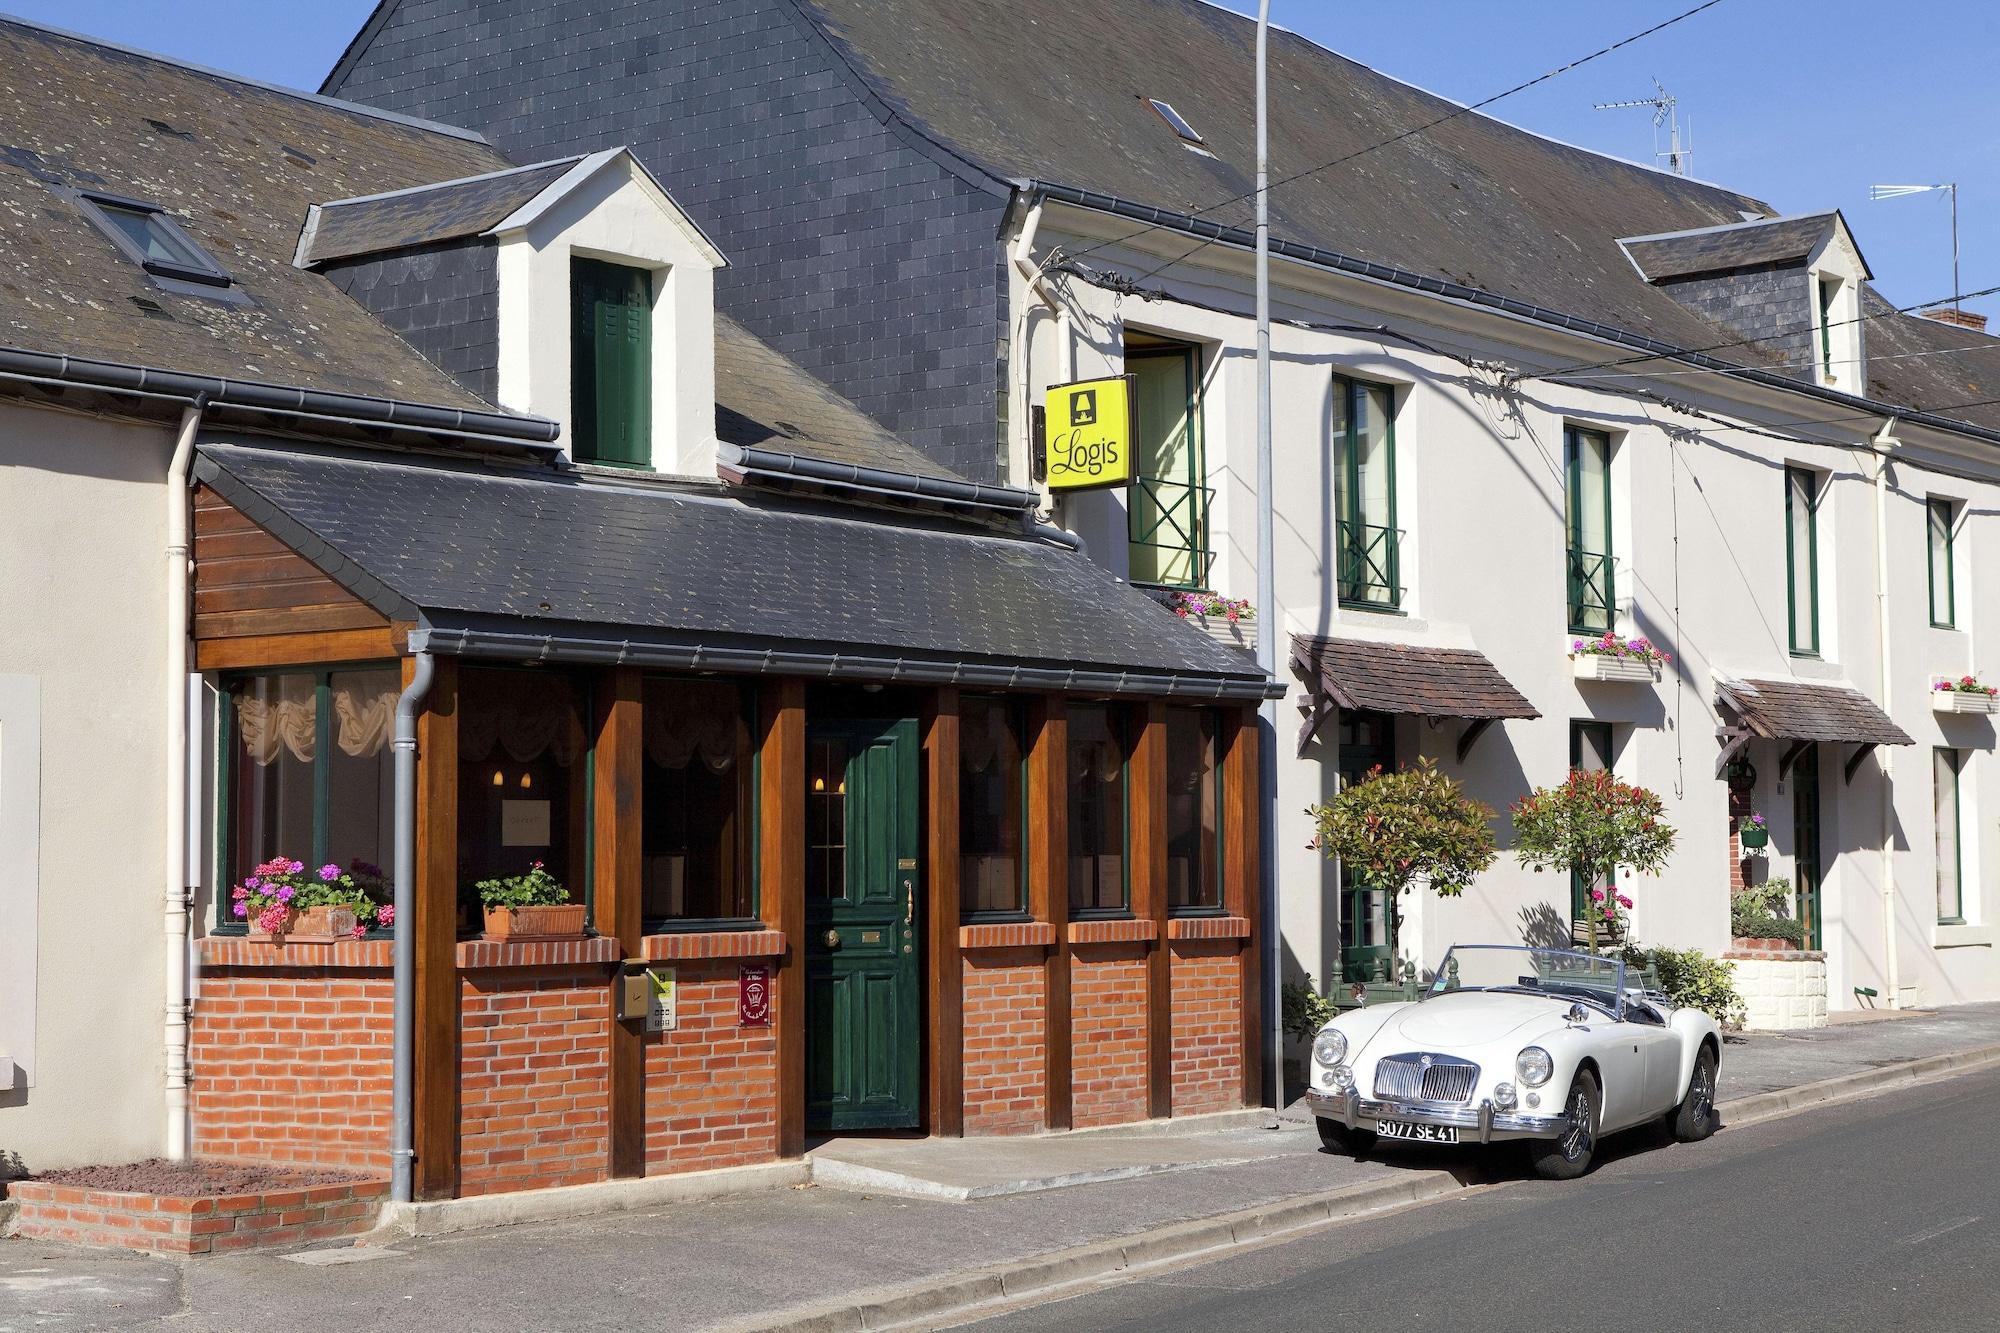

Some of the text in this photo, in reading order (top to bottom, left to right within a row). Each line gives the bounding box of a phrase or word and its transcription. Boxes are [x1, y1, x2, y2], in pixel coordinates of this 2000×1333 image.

[1051, 429, 1118, 475] Logis
[1379, 1120, 1455, 1142] 5077 SE 41
